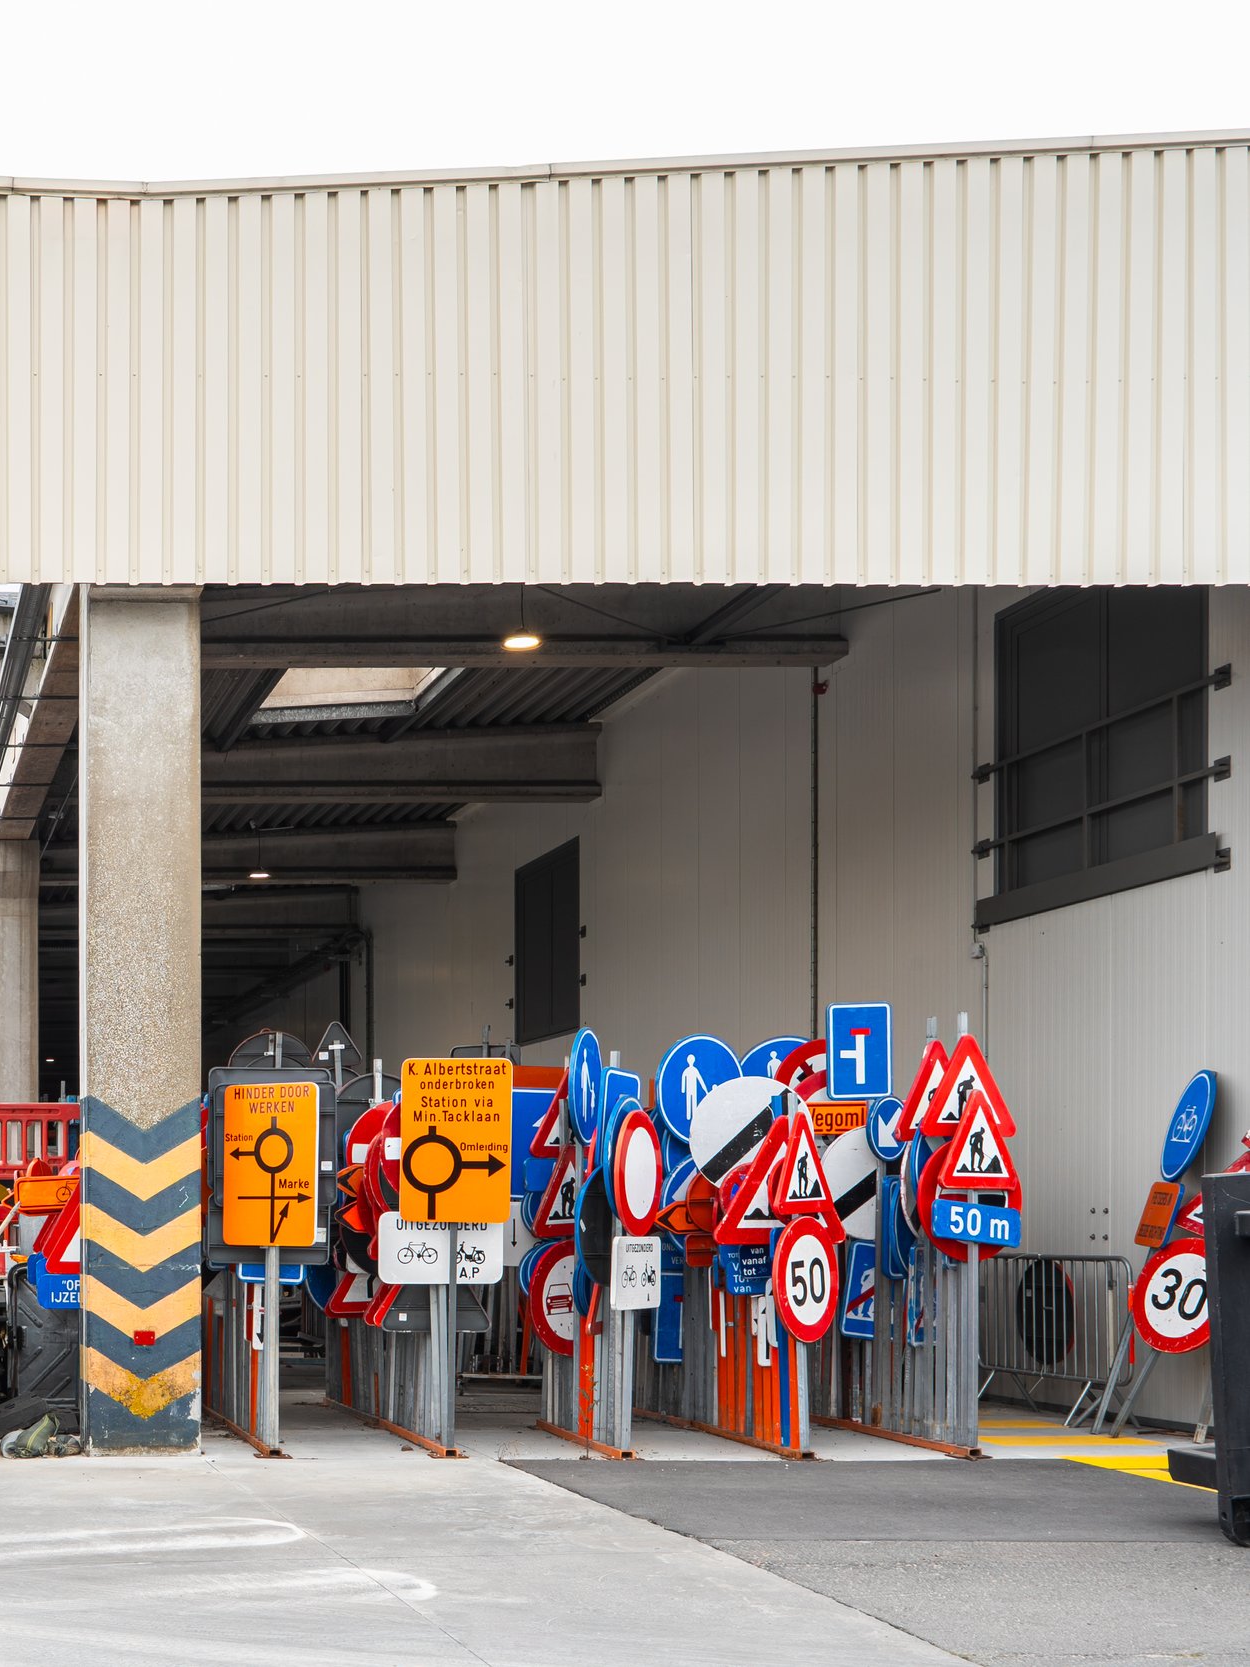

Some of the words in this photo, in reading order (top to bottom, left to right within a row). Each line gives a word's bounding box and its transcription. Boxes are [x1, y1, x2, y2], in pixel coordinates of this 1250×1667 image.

[408, 1063, 419, 1075] K.
[424, 1063, 507, 1075] Albertstraat
[420, 1079, 495, 1090] onderbroken
[234, 1087, 275, 1100] HINDER
[280, 1085, 310, 1098] DOOR
[249, 1101, 295, 1114] WERKEN
[421, 1096, 467, 1108] Station
[474, 1096, 493, 1108] via
[413, 1111, 500, 1122] Min.Tacklaan
[225, 1133, 253, 1142] Station
[459, 1142, 508, 1154] Omleiding
[278, 1179, 310, 1189] Marke
[950, 1206, 982, 1236] 50
[990, 1218, 1010, 1240] m
[625, 1243, 654, 1253] UITGEZONDERD
[750, 1247, 764, 1255] van
[741, 1255, 767, 1266] vanaf
[743, 1267, 757, 1276] tot
[791, 1257, 826, 1307] 50
[733, 1285, 752, 1293] van
[1151, 1268, 1208, 1321] 30
